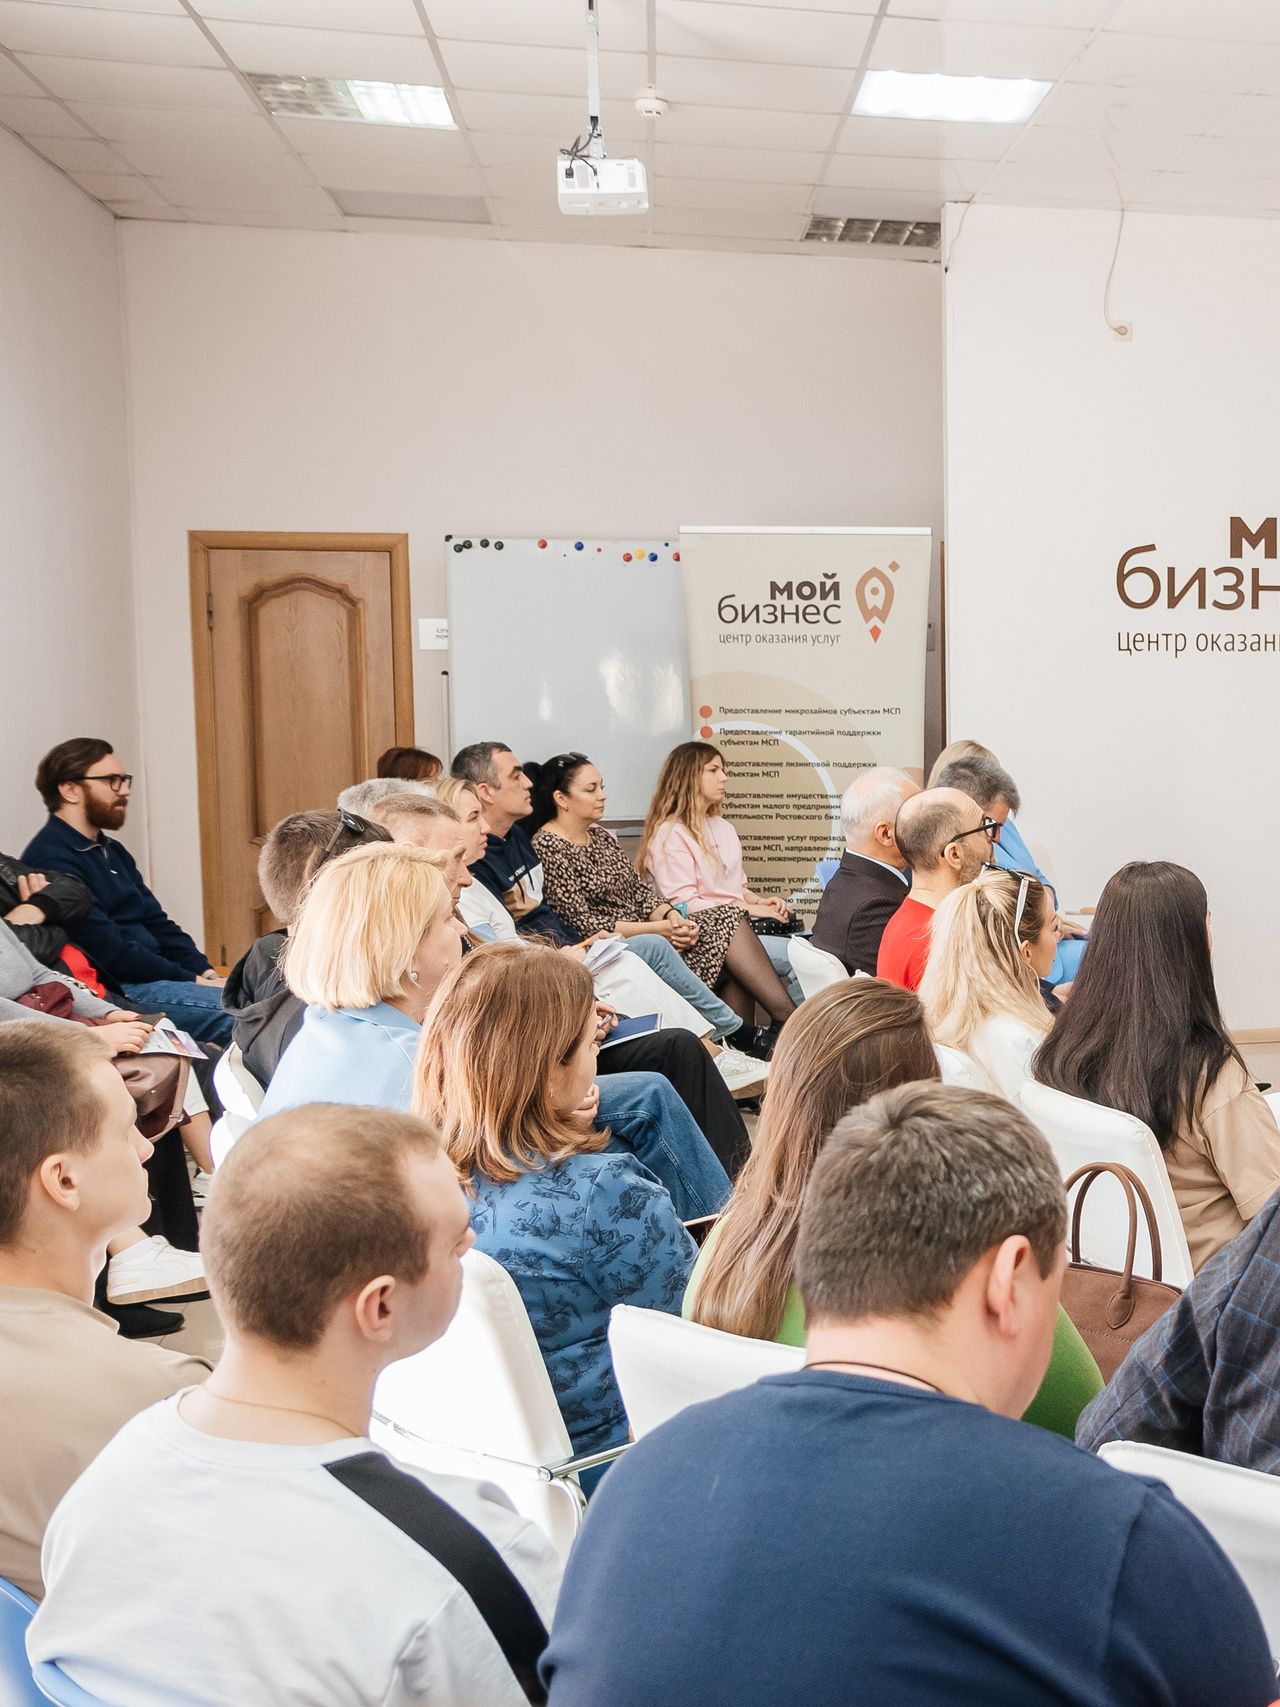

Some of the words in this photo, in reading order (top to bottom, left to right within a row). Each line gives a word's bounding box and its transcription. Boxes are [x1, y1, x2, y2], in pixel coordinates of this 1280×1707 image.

[770, 572, 841, 601] мой
[717, 594, 841, 624] бизнес
[718, 633, 752, 646] центр
[754, 634, 808, 644] оказания
[810, 634, 841, 647] услуг
[1117, 631, 1187, 657] центр
[719, 706, 783, 715] Предоставление
[785, 707, 838, 716] микрозаймов
[840, 708, 880, 716] субъектам
[719, 728, 782, 736] Предоставление
[785, 729, 834, 737] гарантийной
[720, 738, 759, 747] субъектам
[832, 761, 877, 769] поддержки
[725, 770, 760, 778] убъектам
[788, 877, 807, 885] услуг
